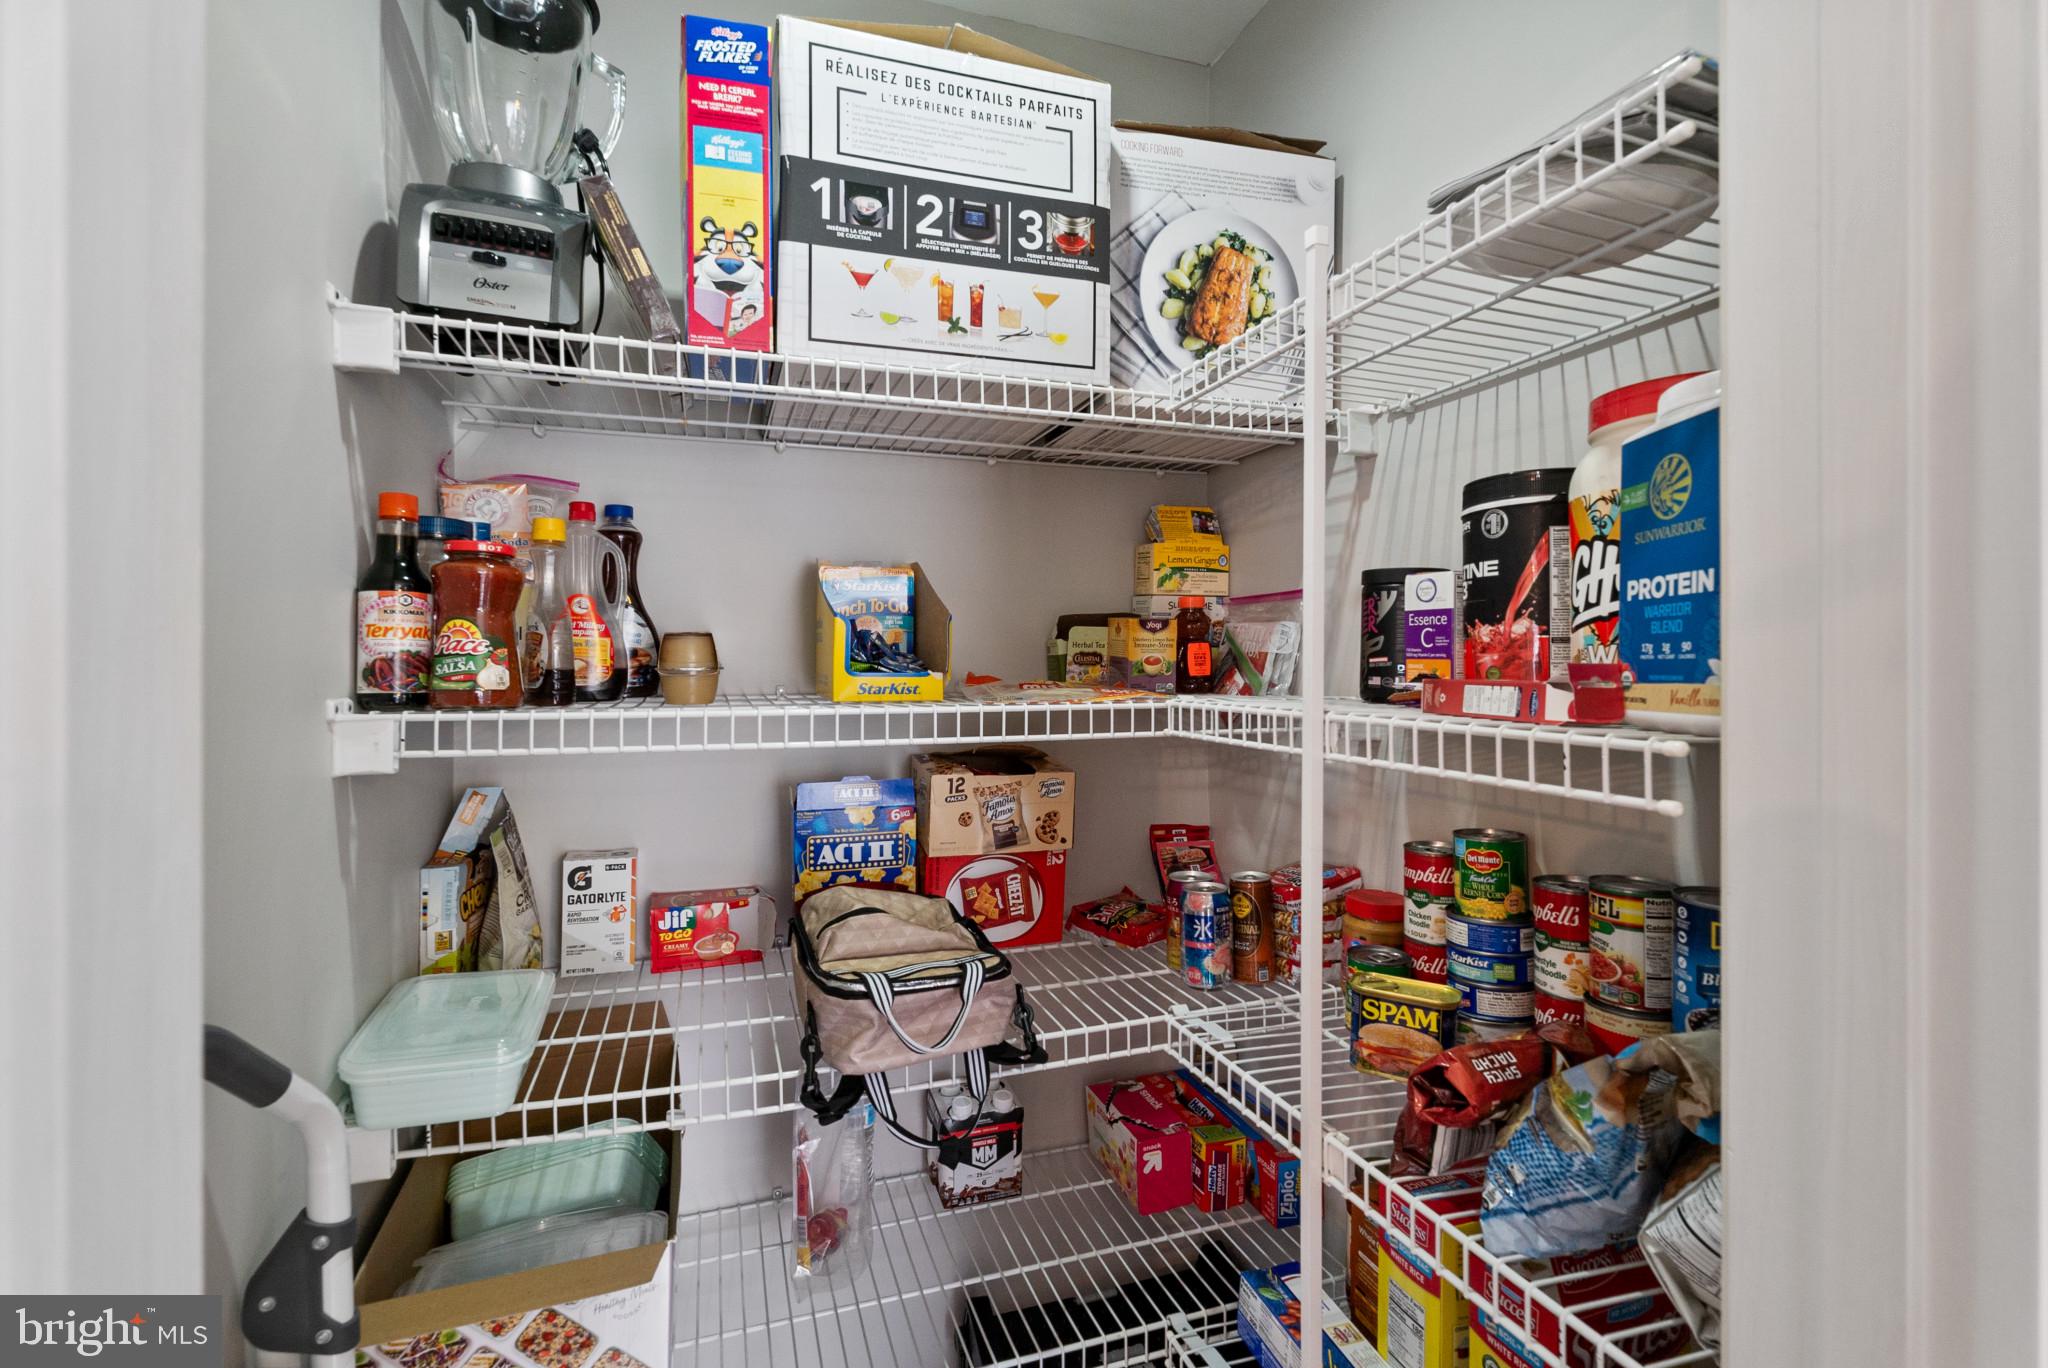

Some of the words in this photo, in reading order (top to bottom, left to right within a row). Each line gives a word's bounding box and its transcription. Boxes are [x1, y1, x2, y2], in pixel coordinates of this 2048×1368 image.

[694, 39, 757, 53] FROSTED
[698, 51, 751, 64] FLAKES
[698, 81, 719, 93] NEED
[721, 84, 727, 93] A
[728, 85, 757, 98] CEREAL
[825, 57, 898, 85] RÉALISEZ
[905, 75, 931, 92] DES
[938, 82, 1013, 108] COCKTAILS
[1019, 97, 1083, 120] PARFAITS
[713, 92, 743, 104] BREAK?
[881, 92, 965, 118] L'EXPÉRIENCE
[970, 109, 1034, 130] BARTESIAN
[1120, 138, 1149, 153] COOKING
[810, 177, 831, 220] 1
[915, 193, 944, 237] 2
[1017, 209, 1043, 251] 3
[473, 277, 510, 291] Oster
[1634, 517, 1706, 545] SUNWARRIOR
[478, 543, 502, 552] HOT
[1193, 556, 1218, 567] Ginger
[844, 578, 900, 592] StarKist
[1627, 568, 1715, 601] PROTEIN
[1644, 601, 1692, 619] WARRIOR
[1408, 614, 1448, 626] Essence
[1651, 620, 1683, 634] BLEND
[435, 633, 490, 656] Pace
[1072, 641, 1094, 649] Herbal
[1421, 627, 1433, 648] C
[435, 661, 476, 675] SALSA
[857, 683, 918, 695] StarKist
[1670, 688, 1701, 707] Vanilla
[947, 777, 966, 794] 12
[1038, 778, 1065, 793] Famous
[1040, 788, 1063, 798] Amos
[983, 795, 1016, 816] Famous
[891, 809, 900, 820] 6
[987, 806, 1015, 823] Amos
[817, 843, 865, 865] ACT
[868, 841, 895, 861] II
[1479, 856, 1500, 865] Monte
[1463, 888, 1486, 897] KERNEL
[1487, 890, 1505, 898] CORN
[1472, 882, 1495, 891] WHOLE
[567, 891, 626, 906] GATORLYTE
[658, 909, 693, 930] Jif
[1408, 909, 1431, 921] Chicken
[1409, 918, 1430, 929] Noodle
[659, 933, 672, 941] TO
[673, 928, 692, 939] GO
[1410, 930, 1428, 938] SOUP
[664, 943, 688, 951] CREAMY
[1451, 951, 1489, 968] StarKist
[1541, 967, 1567, 981] Noodle
[1362, 998, 1440, 1033] SPAM
[1472, 1052, 1517, 1072] NACHO
[1485, 1066, 1522, 1084] SPICY
[1140, 1090, 1163, 1110] snack
[1190, 1098, 1213, 1120] Hefty
[1143, 1143, 1161, 1152] snack
[1208, 1166, 1217, 1190] Hefty
[1281, 1170, 1297, 1216] Ziploc
[1390, 1247, 1409, 1271] WHITE
[1410, 1265, 1425, 1285] RICE
[1486, 1334, 1513, 1360] WHITE
